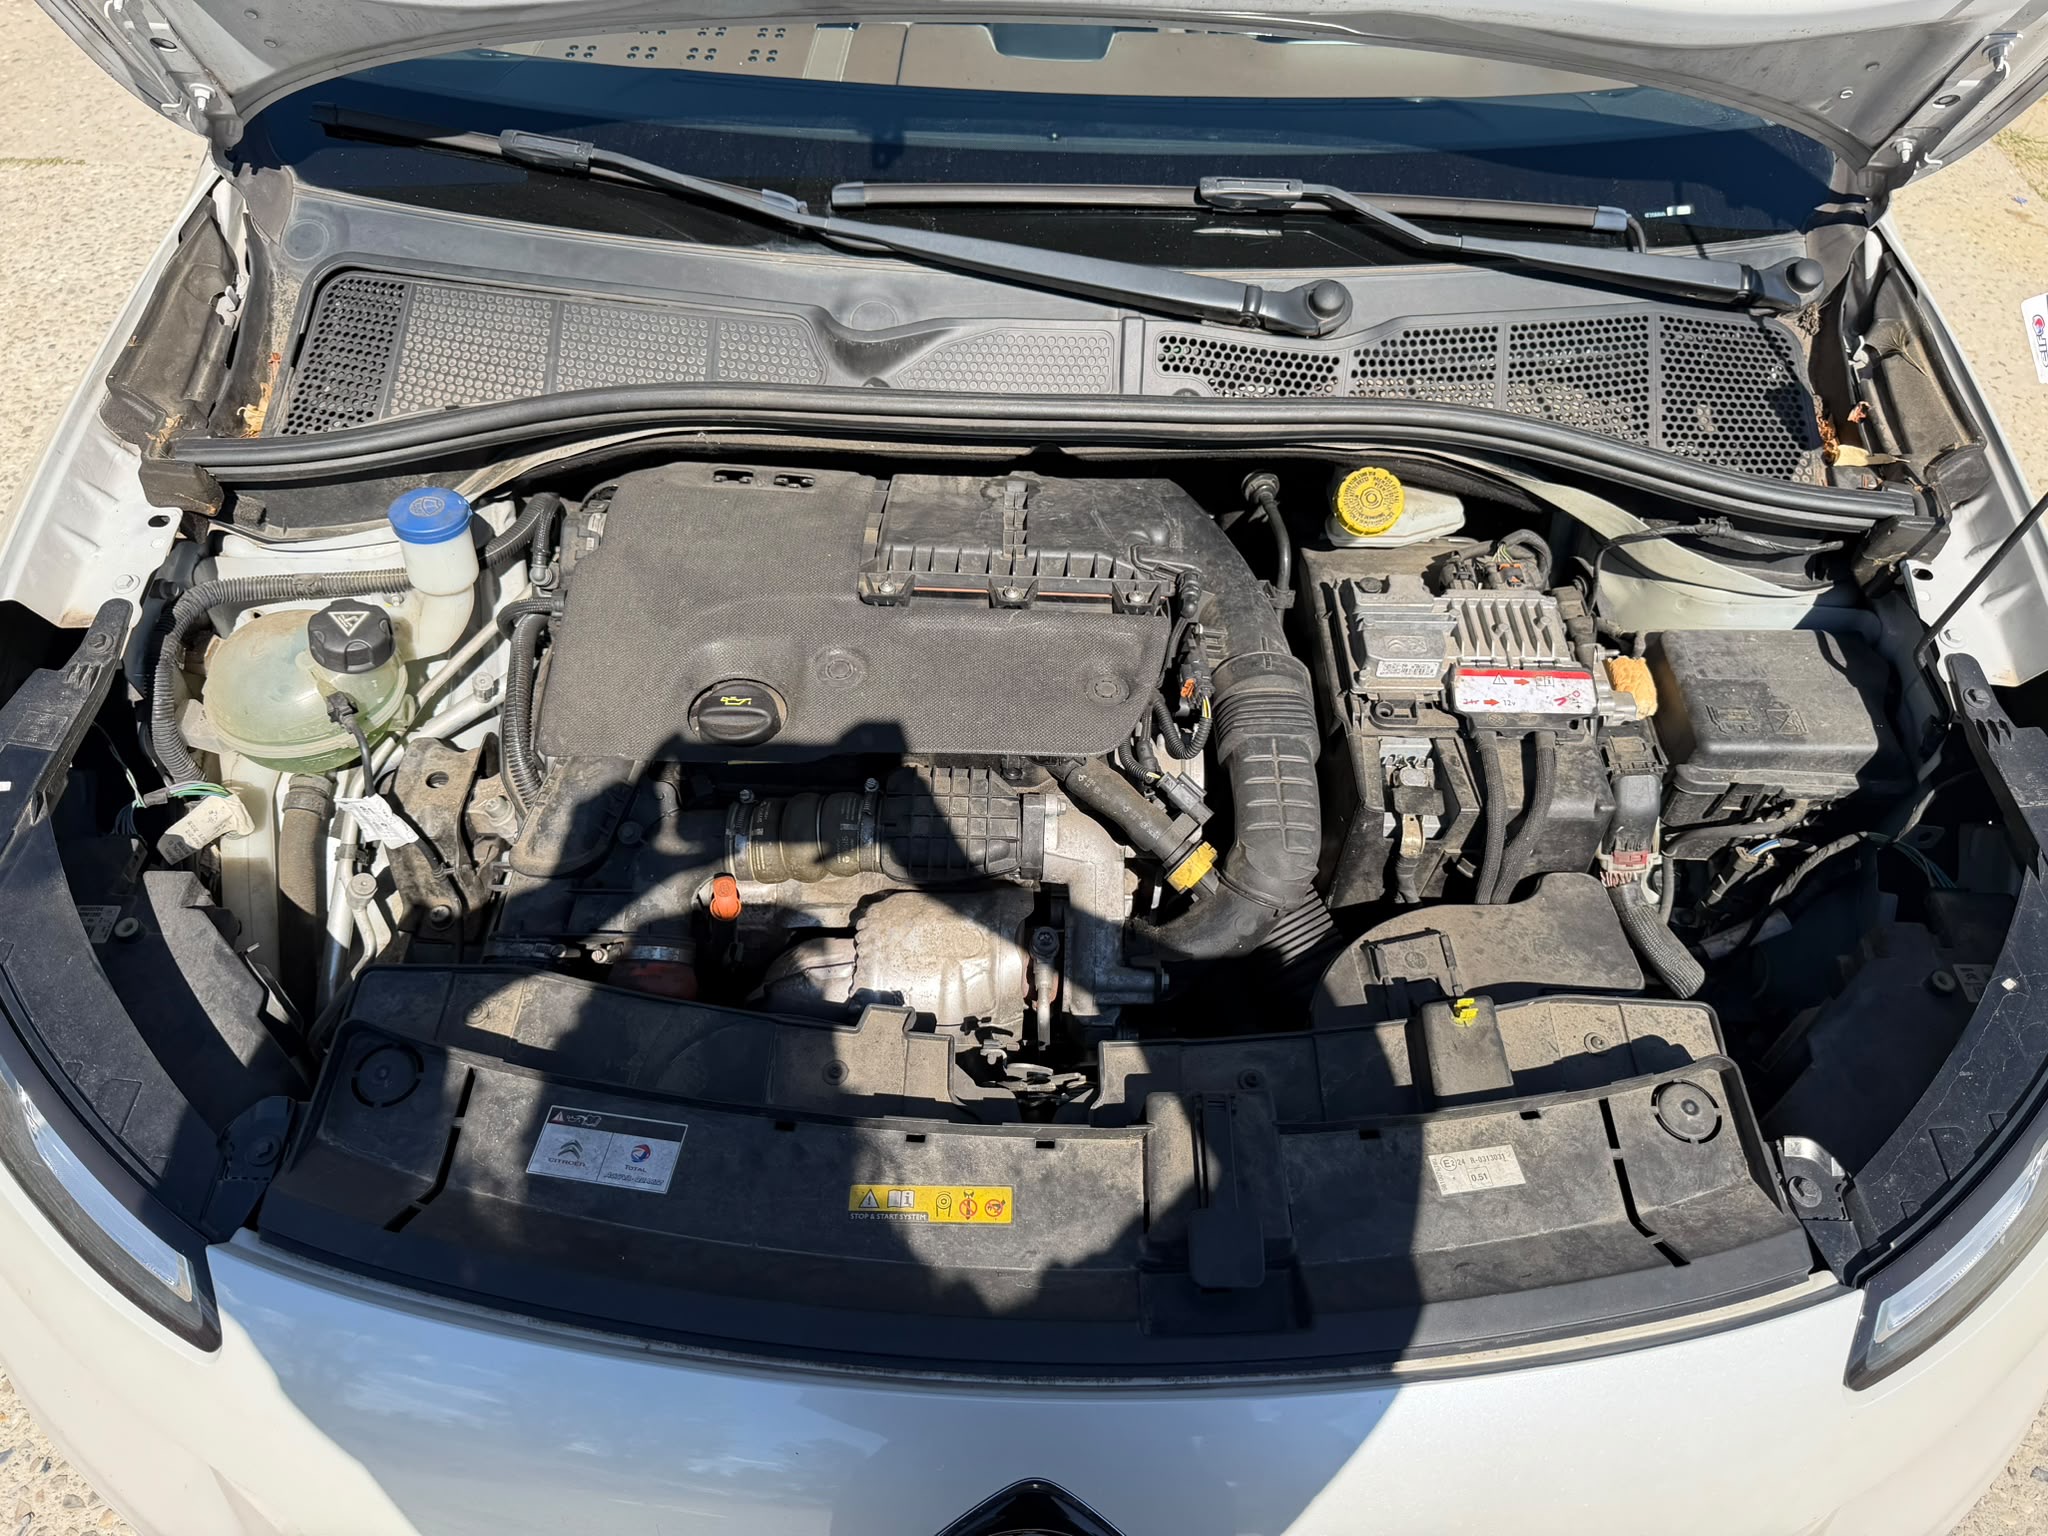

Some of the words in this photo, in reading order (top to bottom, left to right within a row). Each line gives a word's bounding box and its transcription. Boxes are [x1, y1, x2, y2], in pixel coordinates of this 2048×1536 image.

[624, 1164, 647, 1173] TOTAL
[1470, 1172, 1489, 1182] 0.51
[899, 1213, 926, 1221] SYSTEM
